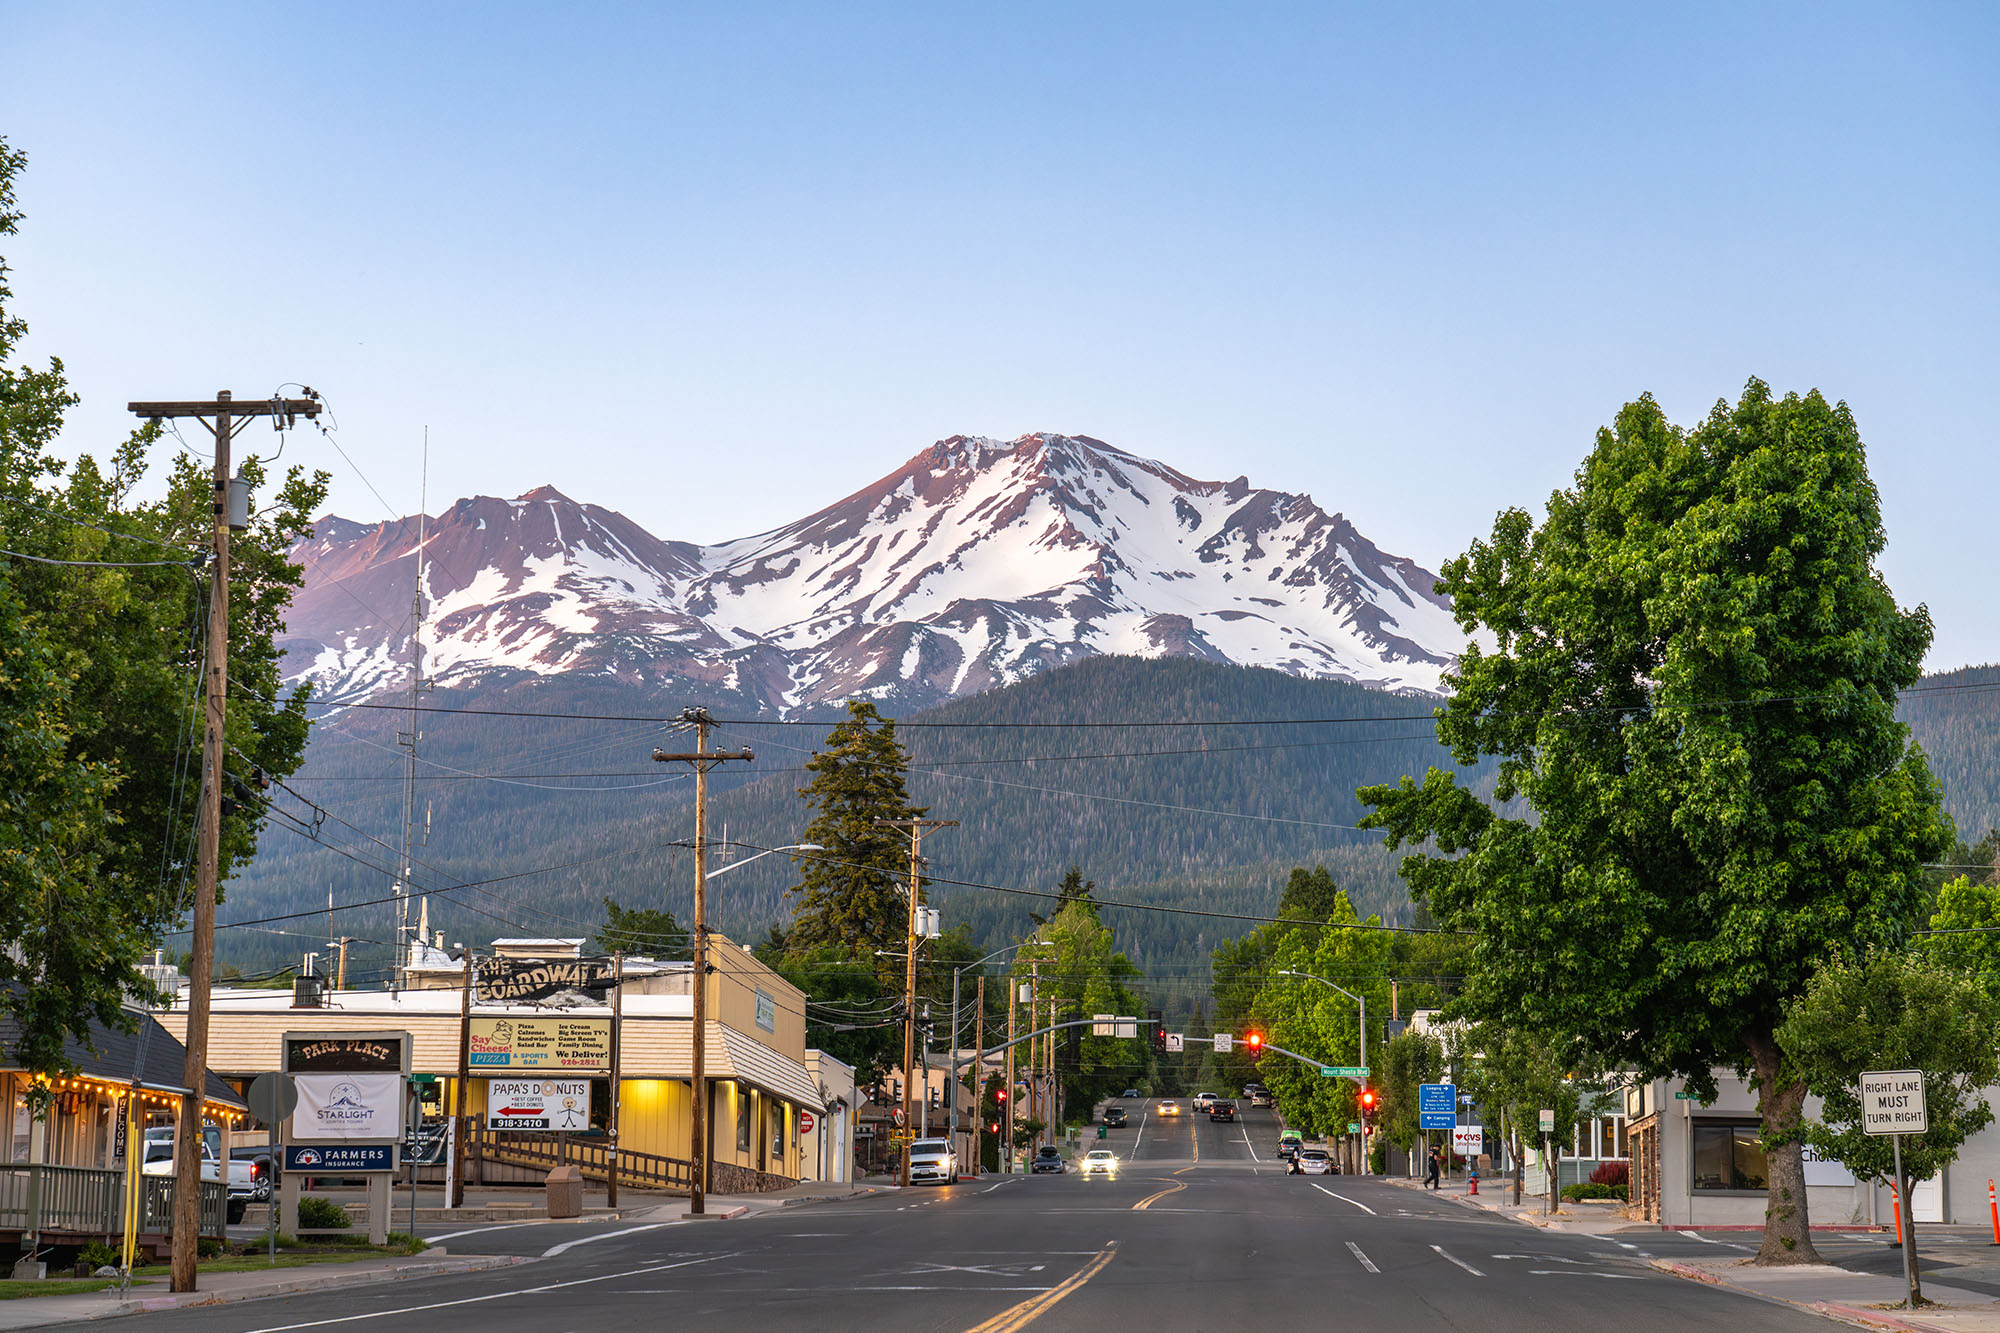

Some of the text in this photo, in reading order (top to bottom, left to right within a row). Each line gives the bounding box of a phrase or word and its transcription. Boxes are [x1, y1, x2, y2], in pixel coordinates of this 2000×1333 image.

[477, 960, 512, 976] THE
[471, 1035, 491, 1045] Say
[302, 1040, 390, 1060] PARK PLACE
[471, 1044, 512, 1053] Cheese!
[494, 1080, 584, 1096] PAPA'S DONUTS
[1866, 1082, 1920, 1093] RIGHT LANE
[1878, 1096, 1908, 1108] MUST
[317, 1110, 374, 1119] STARLIGHT
[1867, 1112, 1922, 1123] TURN RIGHT
[116, 1098, 127, 1155] WELCOME
[325, 1151, 384, 1159] FARMERS
